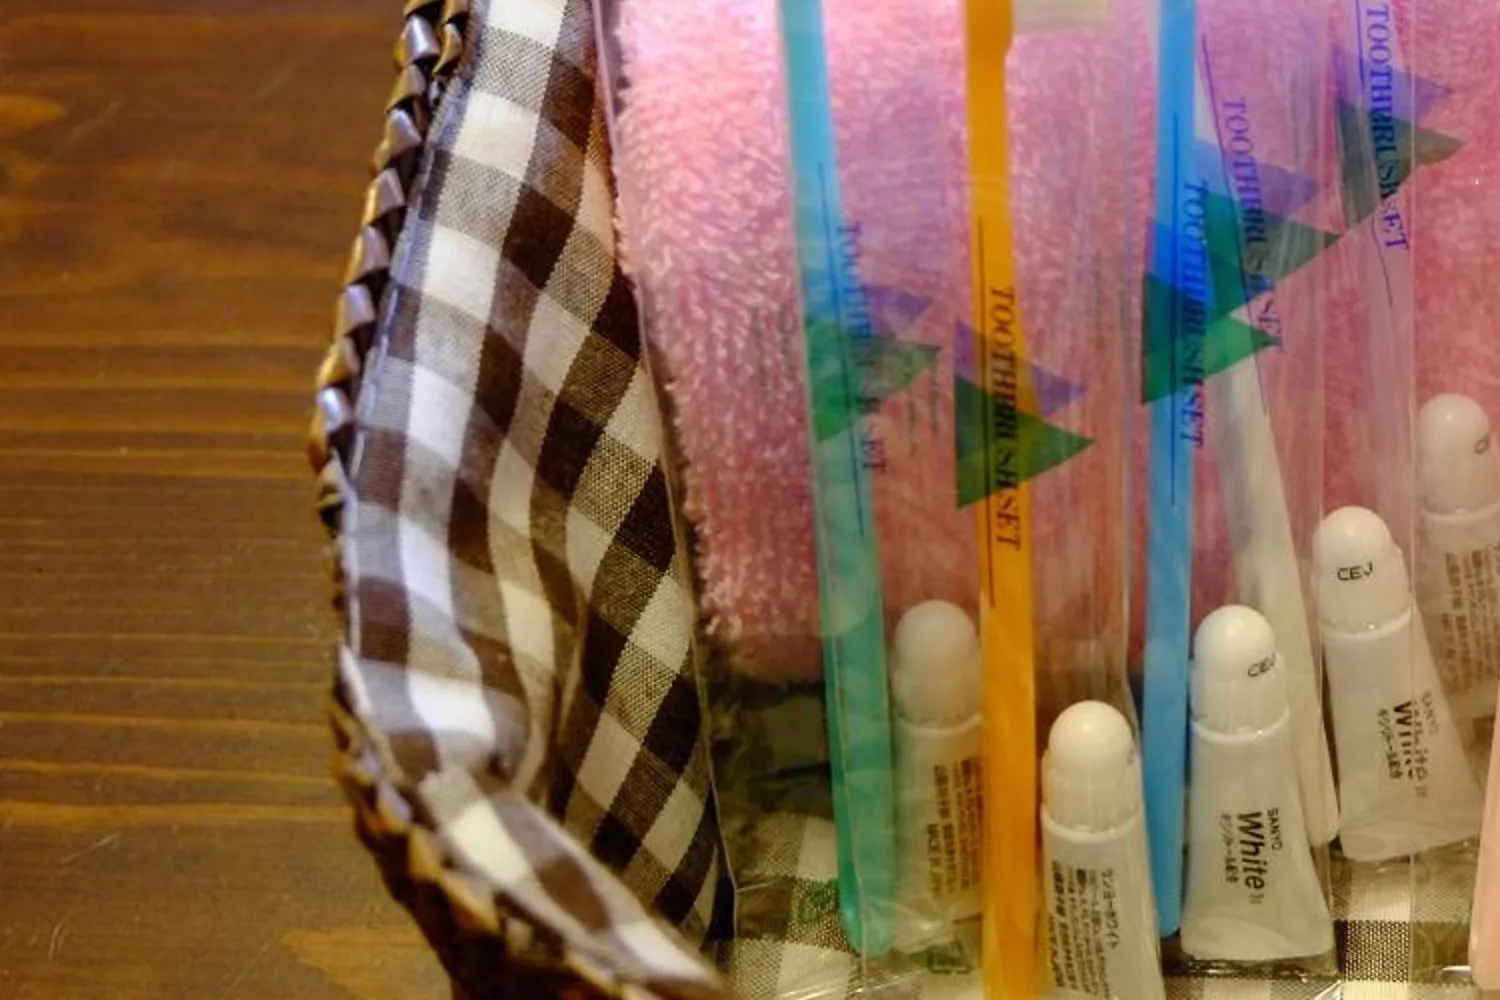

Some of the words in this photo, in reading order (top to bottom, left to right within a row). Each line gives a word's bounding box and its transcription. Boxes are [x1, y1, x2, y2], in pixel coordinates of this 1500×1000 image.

[838, 221, 883, 415] TOOTHBH
[995, 493, 1023, 551] SET
[1336, 561, 1374, 582] CEJ
[1237, 811, 1268, 890] White
[1266, 807, 1283, 851] SANYO
